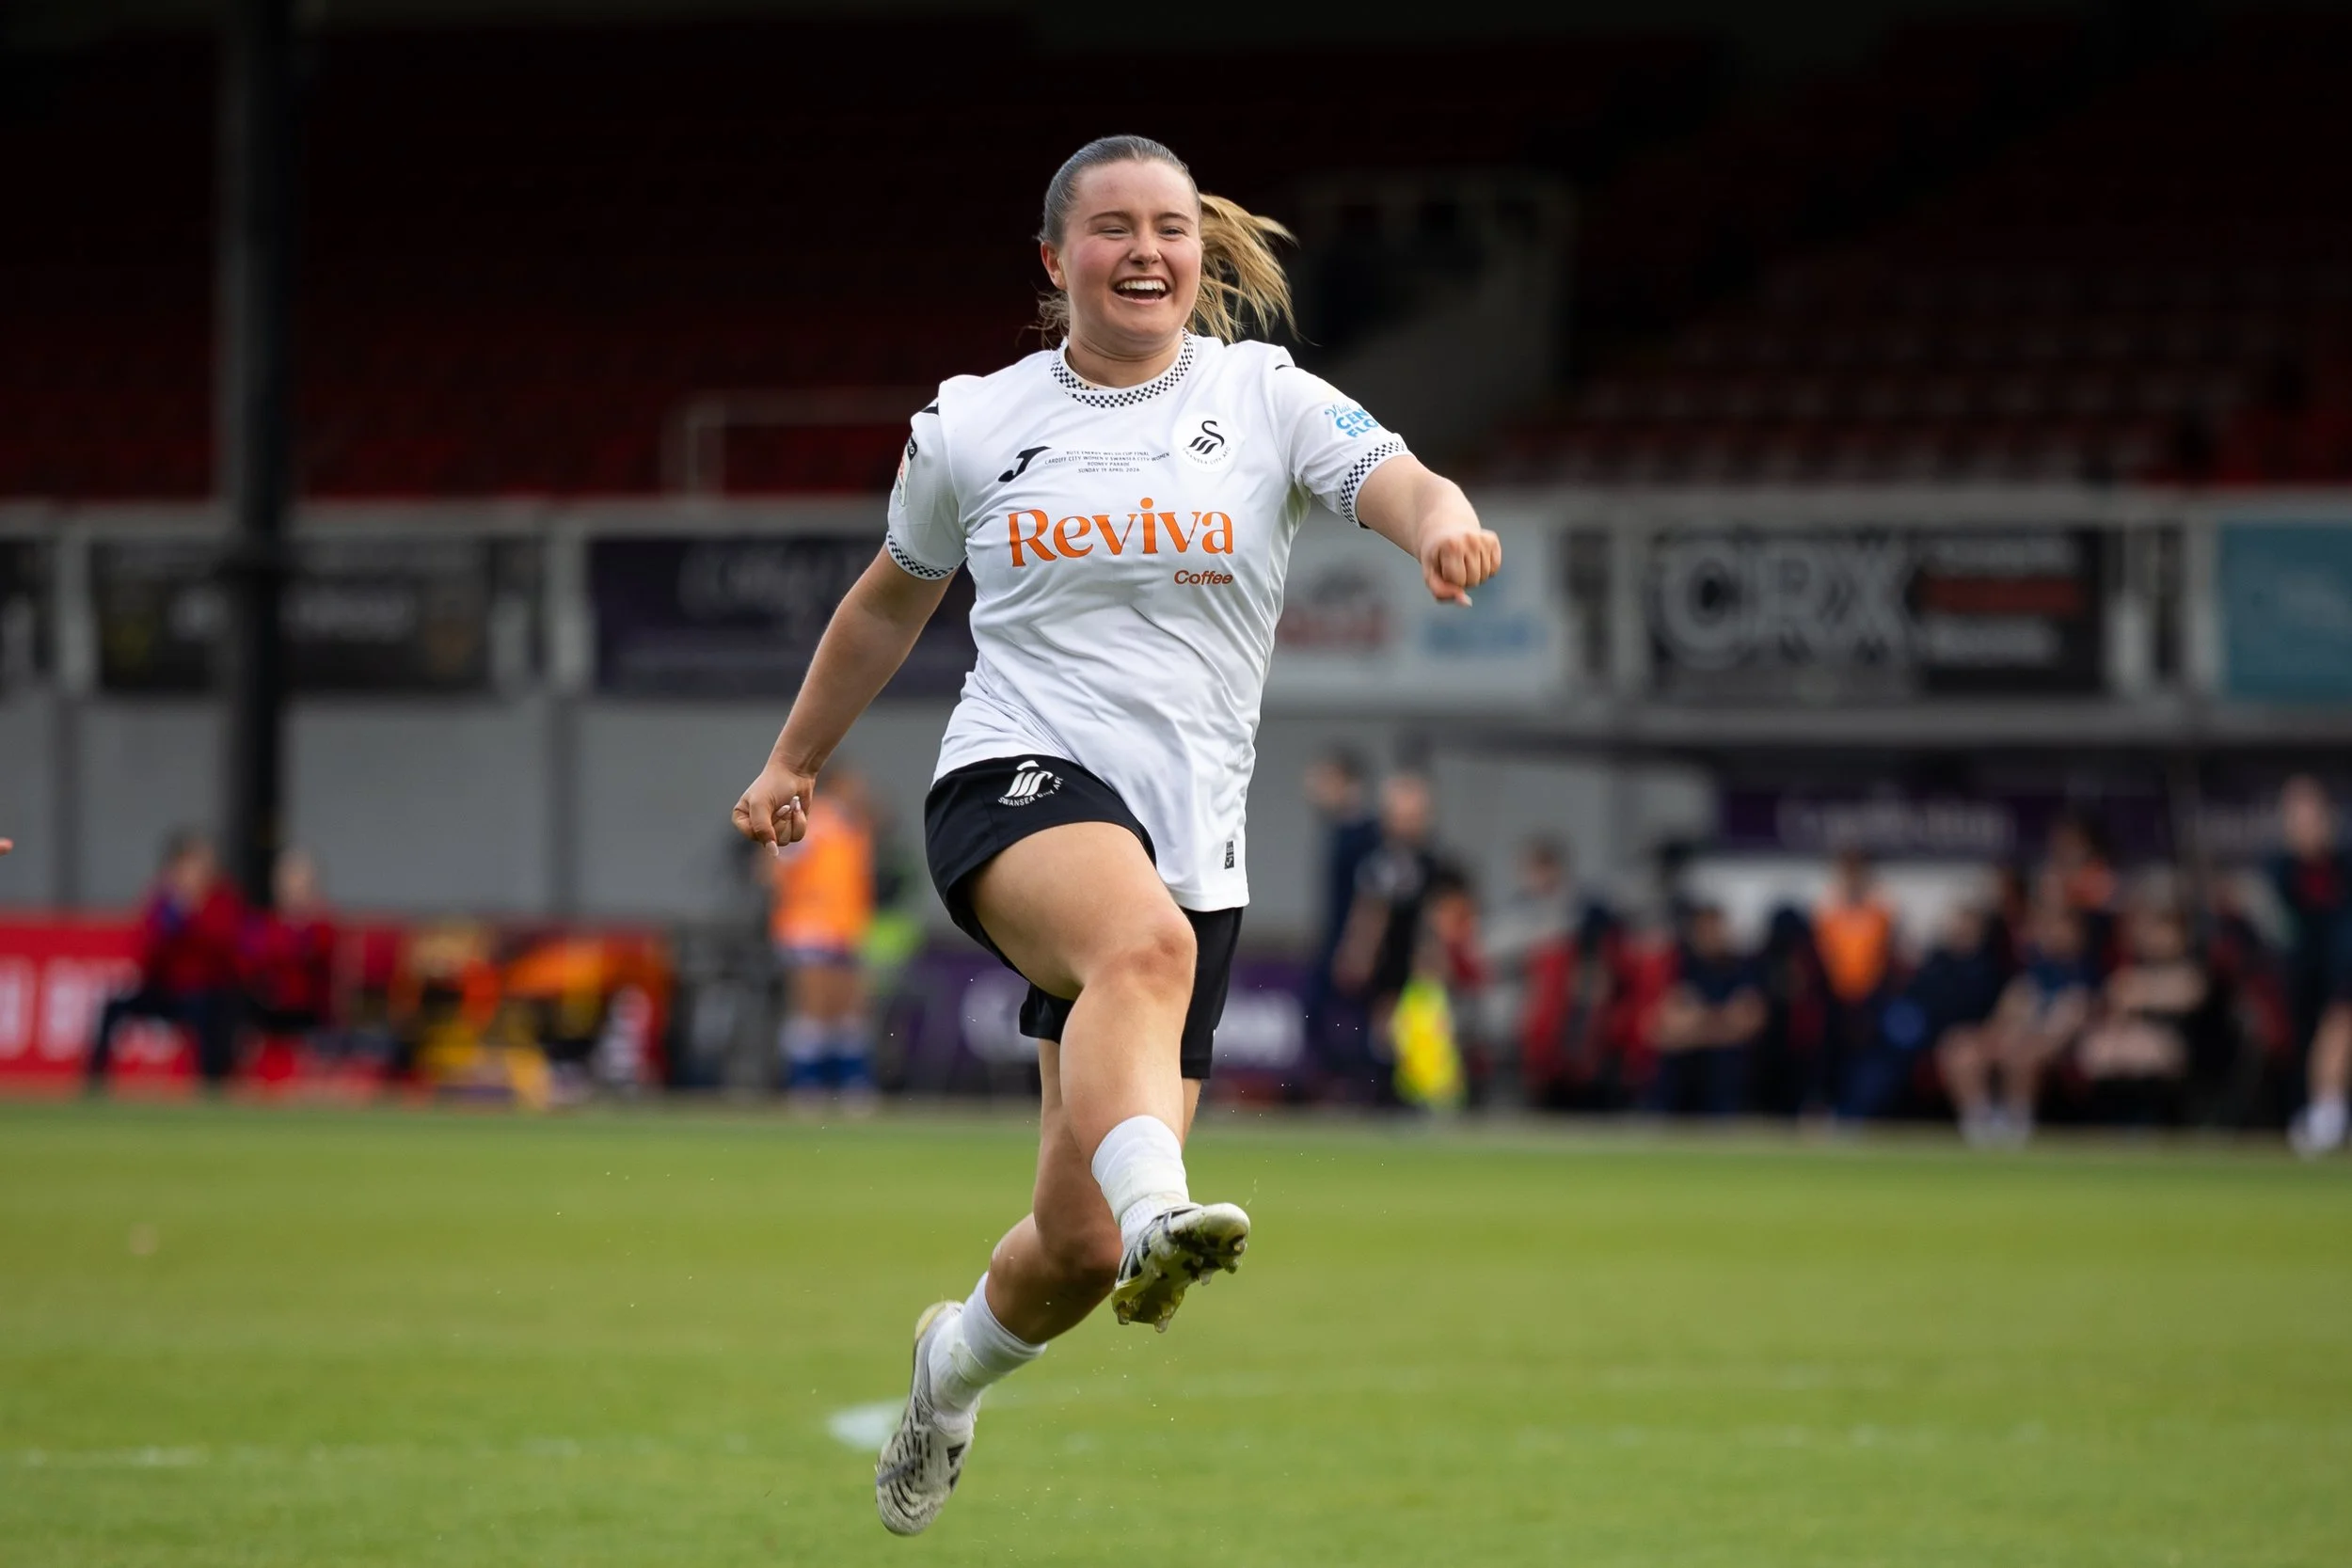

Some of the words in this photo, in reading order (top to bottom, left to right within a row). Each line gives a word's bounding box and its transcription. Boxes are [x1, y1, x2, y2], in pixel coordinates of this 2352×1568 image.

[1044, 456, 1067, 465] CARDIFF
[1151, 451, 1170, 462] WOMEN
[1008, 498, 1233, 567] Reviva
[1174, 570, 1233, 585] Coffee
[997, 796, 1036, 807] SWANSEA
